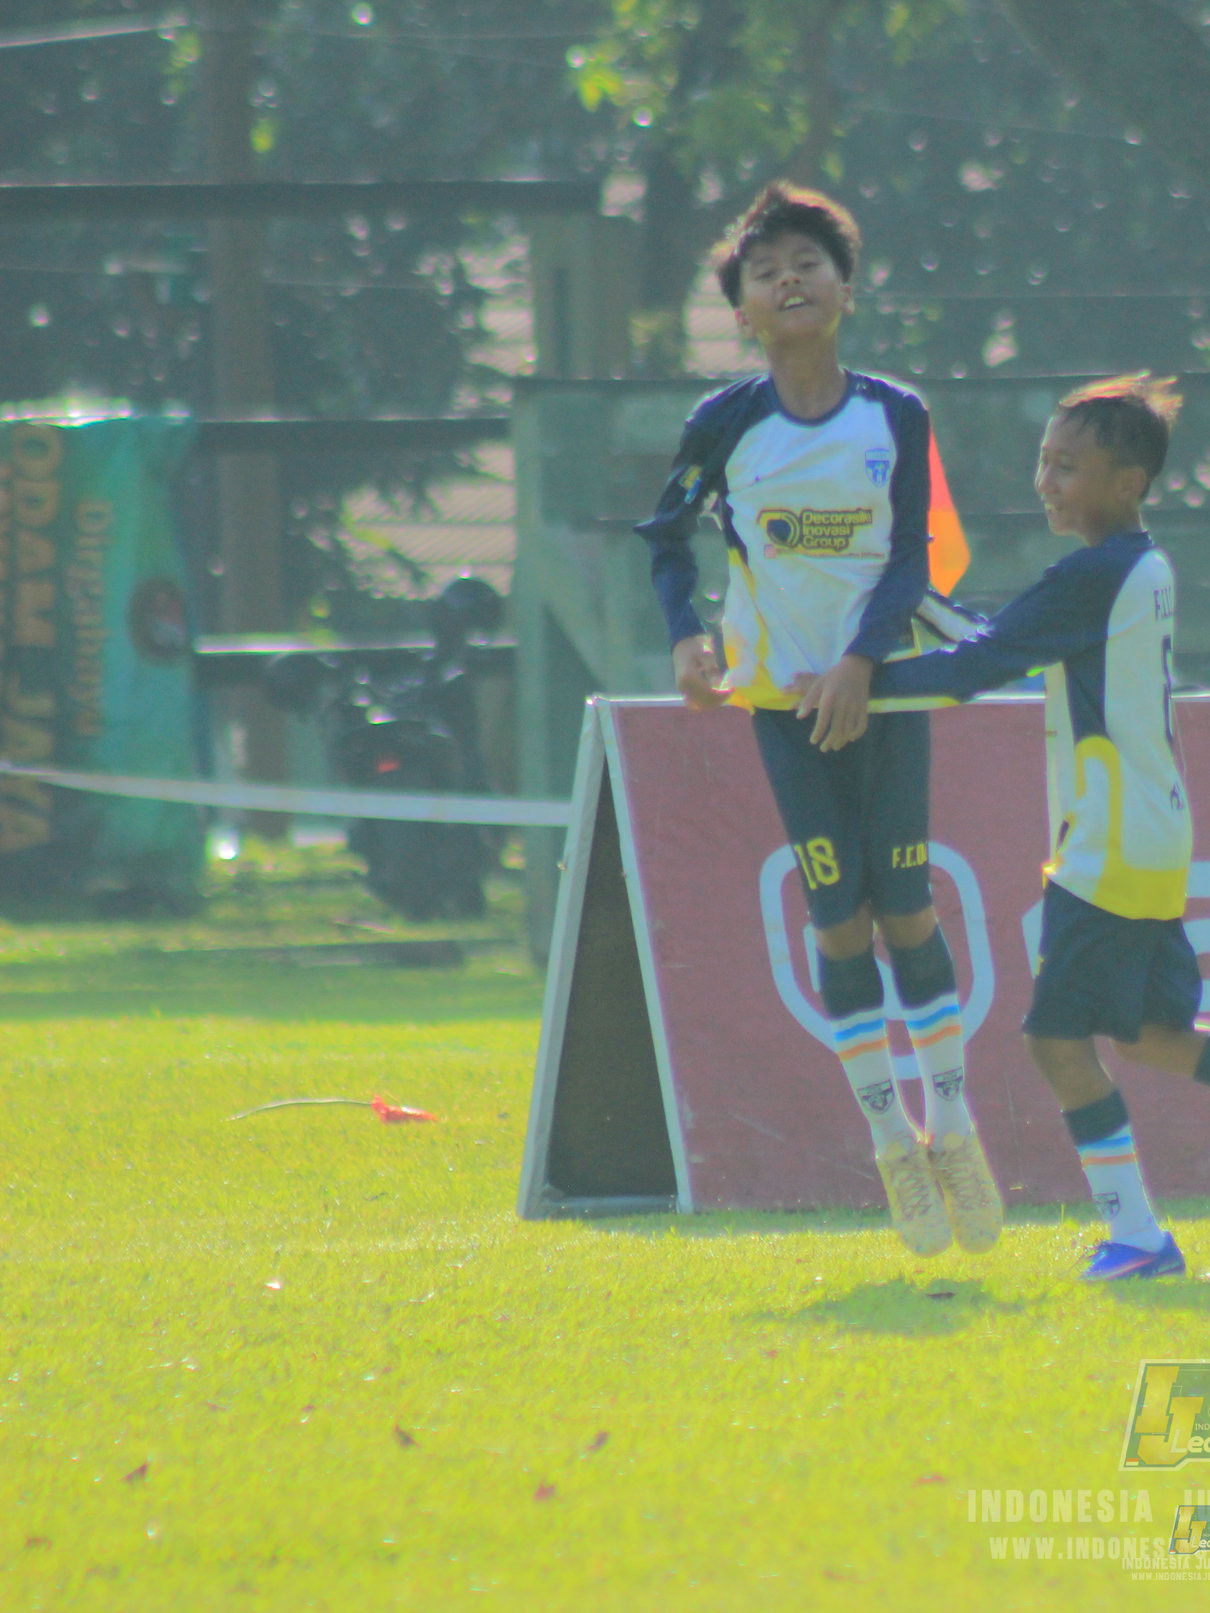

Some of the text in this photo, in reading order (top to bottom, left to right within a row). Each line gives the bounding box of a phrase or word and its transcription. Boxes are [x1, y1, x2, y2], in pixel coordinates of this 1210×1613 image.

[802, 524, 850, 536] Inovasi
[802, 535, 847, 551] Group
[793, 836, 840, 890] 18
